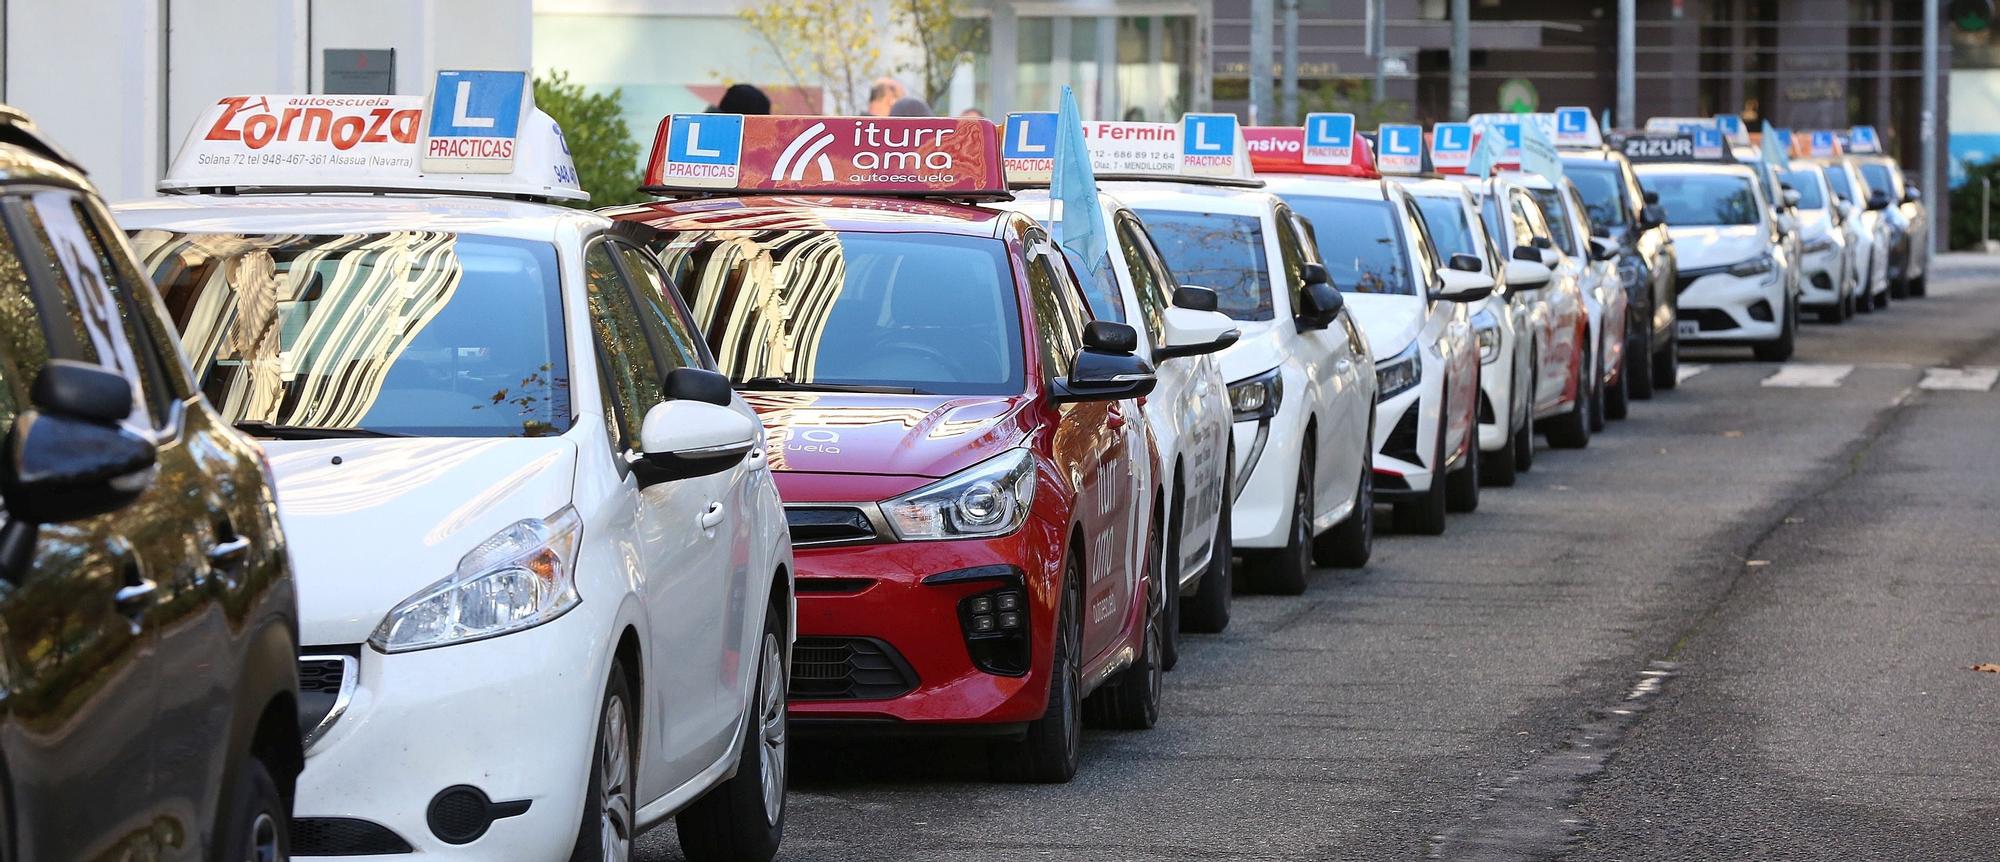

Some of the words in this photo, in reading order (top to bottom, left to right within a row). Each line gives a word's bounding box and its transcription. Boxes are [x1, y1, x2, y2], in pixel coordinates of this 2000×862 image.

[289, 97, 390, 107] autoescuela
[452, 81, 495, 127] L
[1562, 111, 1581, 131] L
[686, 123, 720, 157] L
[854, 120, 954, 148] iturr
[1017, 120, 1046, 152] L
[1195, 122, 1221, 151] L
[1318, 119, 1340, 144] L
[1390, 129, 1411, 153] L
[1442, 127, 1463, 149] L
[429, 139, 512, 158] PRACTICAS
[1150, 152, 1160, 160] 12
[1625, 139, 1692, 156] ZIZUR
[198, 153, 231, 165] Solana
[233, 153, 245, 165] 72
[247, 153, 260, 165] tel
[262, 153, 327, 165] 948-467-361
[329, 154, 366, 166] Alsasua
[368, 155, 413, 168] (Navarra)
[852, 151, 953, 170] ama
[1184, 155, 1232, 167] PRACTICAS
[669, 163, 735, 178] PRACTICAS
[849, 172, 954, 183] autoescuela
